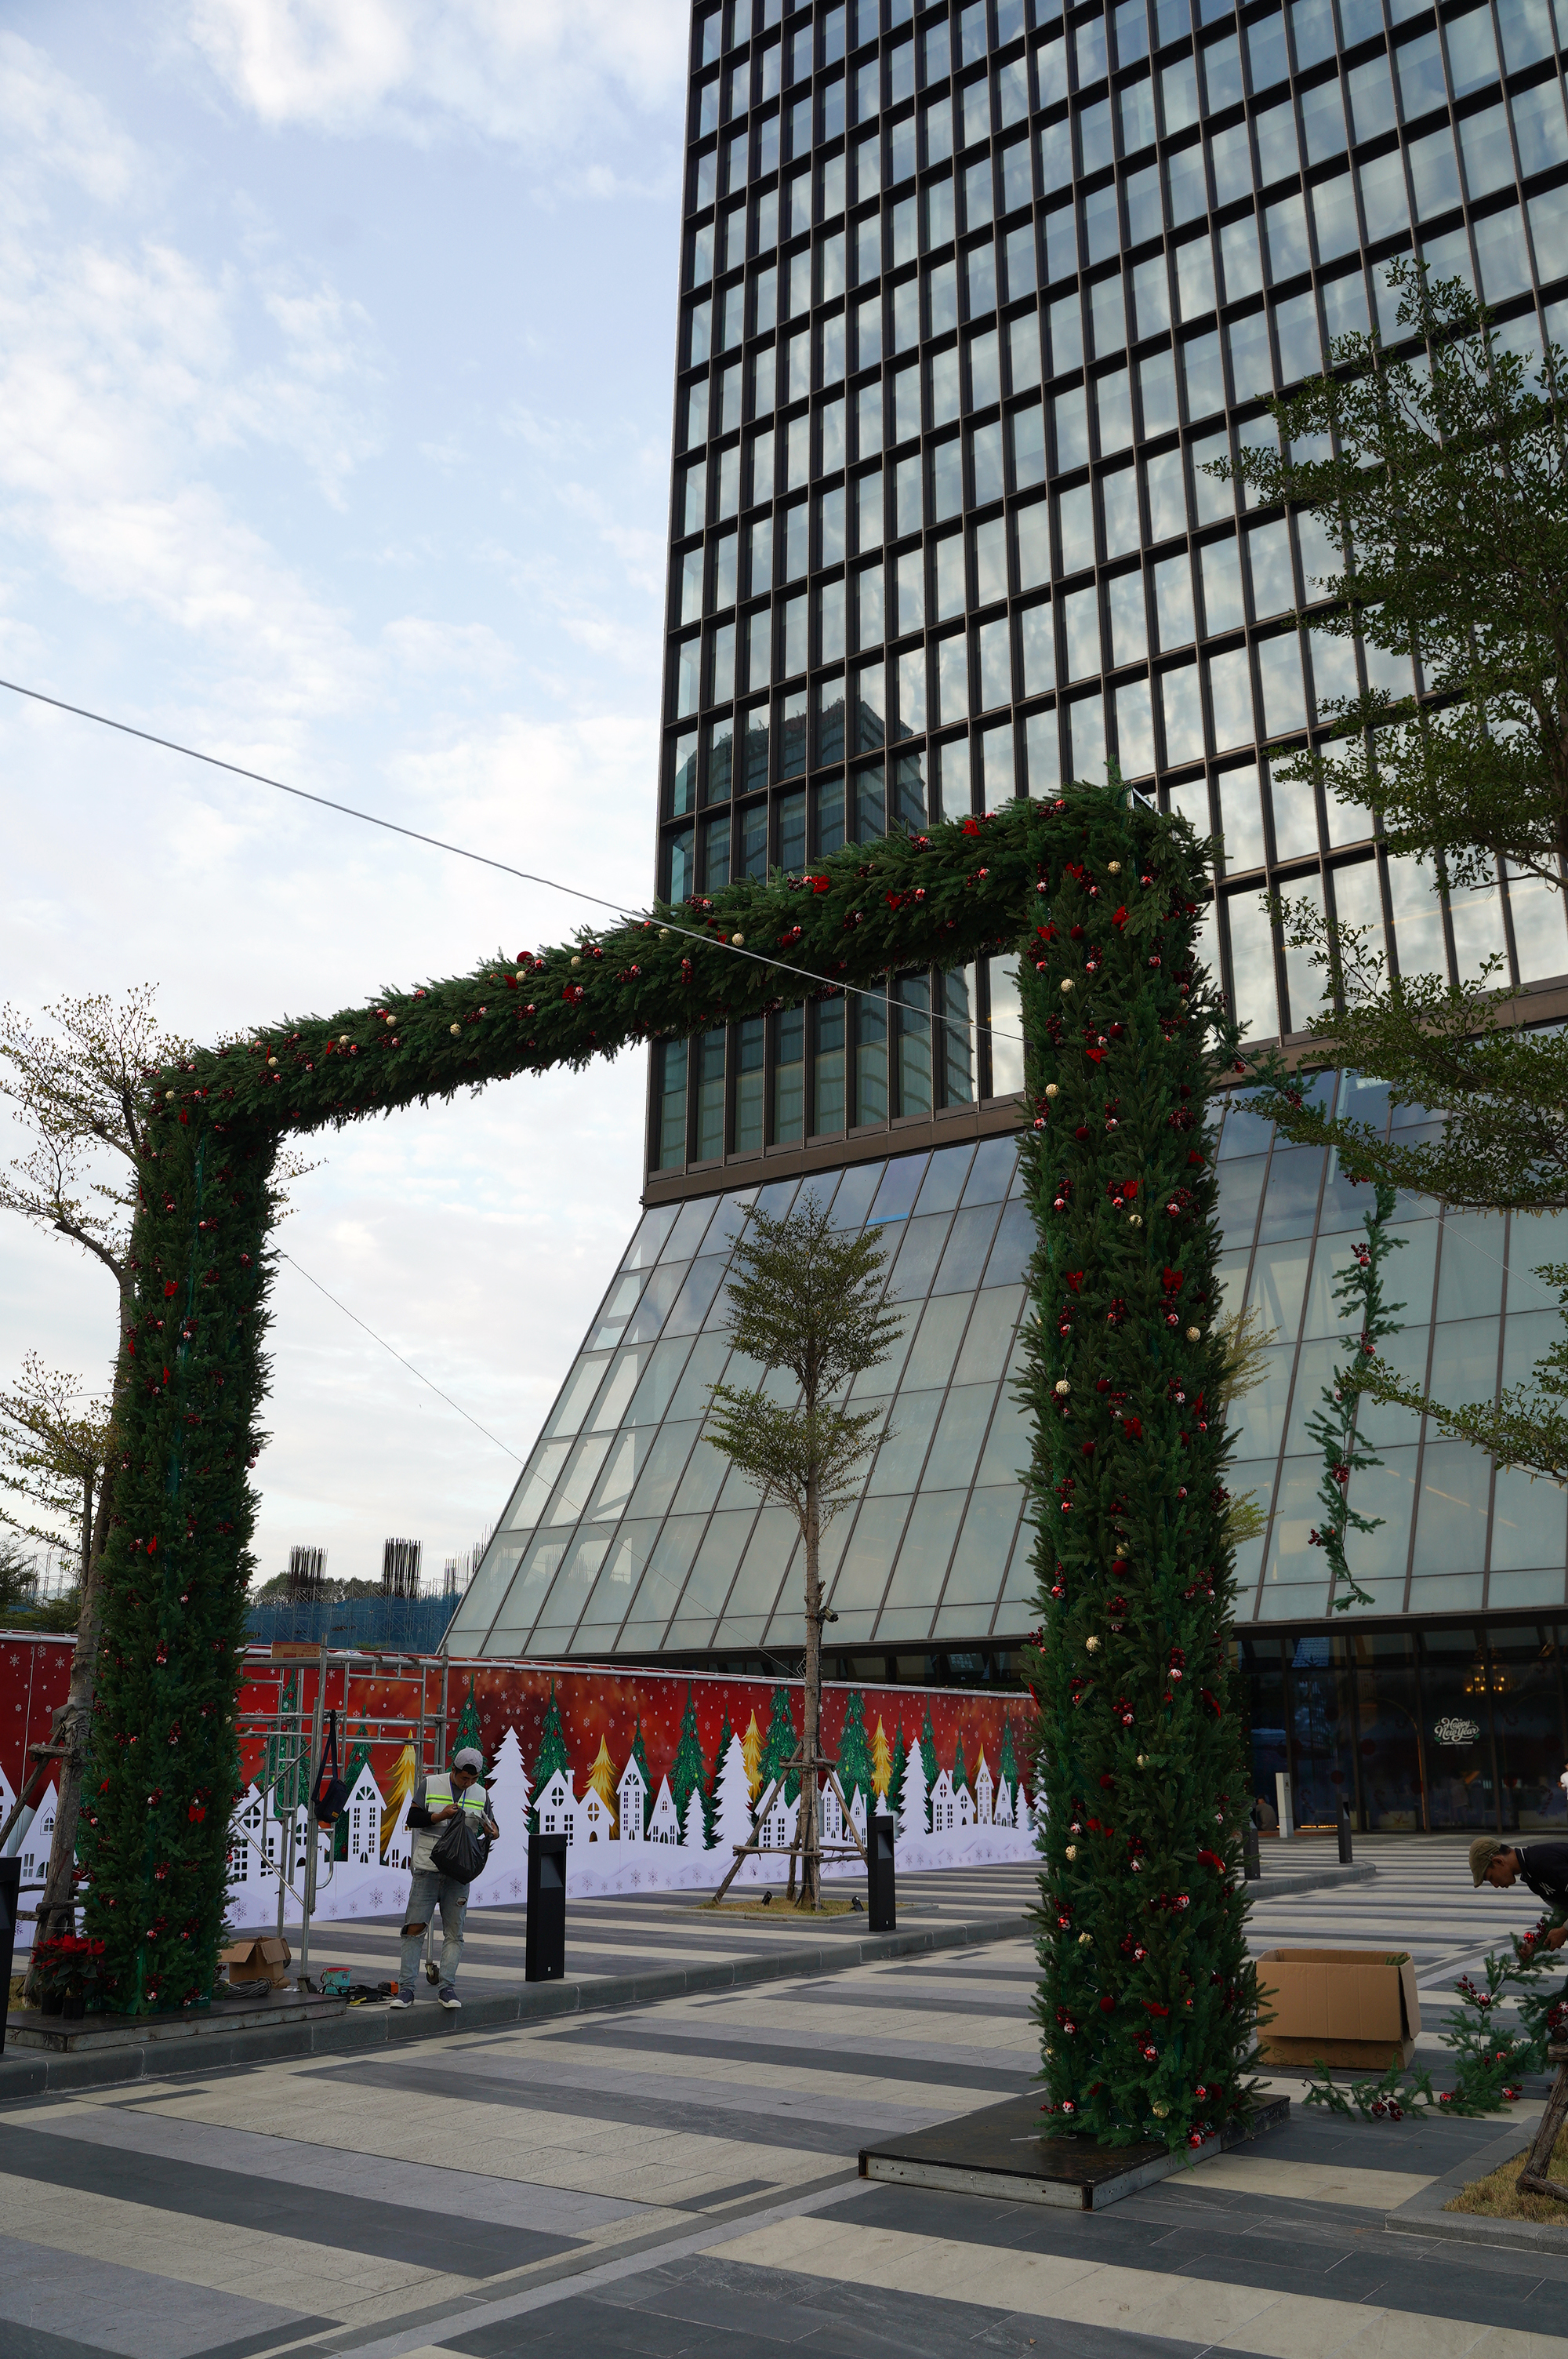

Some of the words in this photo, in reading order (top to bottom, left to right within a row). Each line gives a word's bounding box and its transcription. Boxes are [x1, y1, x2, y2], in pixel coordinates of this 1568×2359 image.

[1441, 1717, 1471, 1730] Happy
[1434, 1725, 1457, 1740] New
[1451, 1725, 1479, 1741] Year
